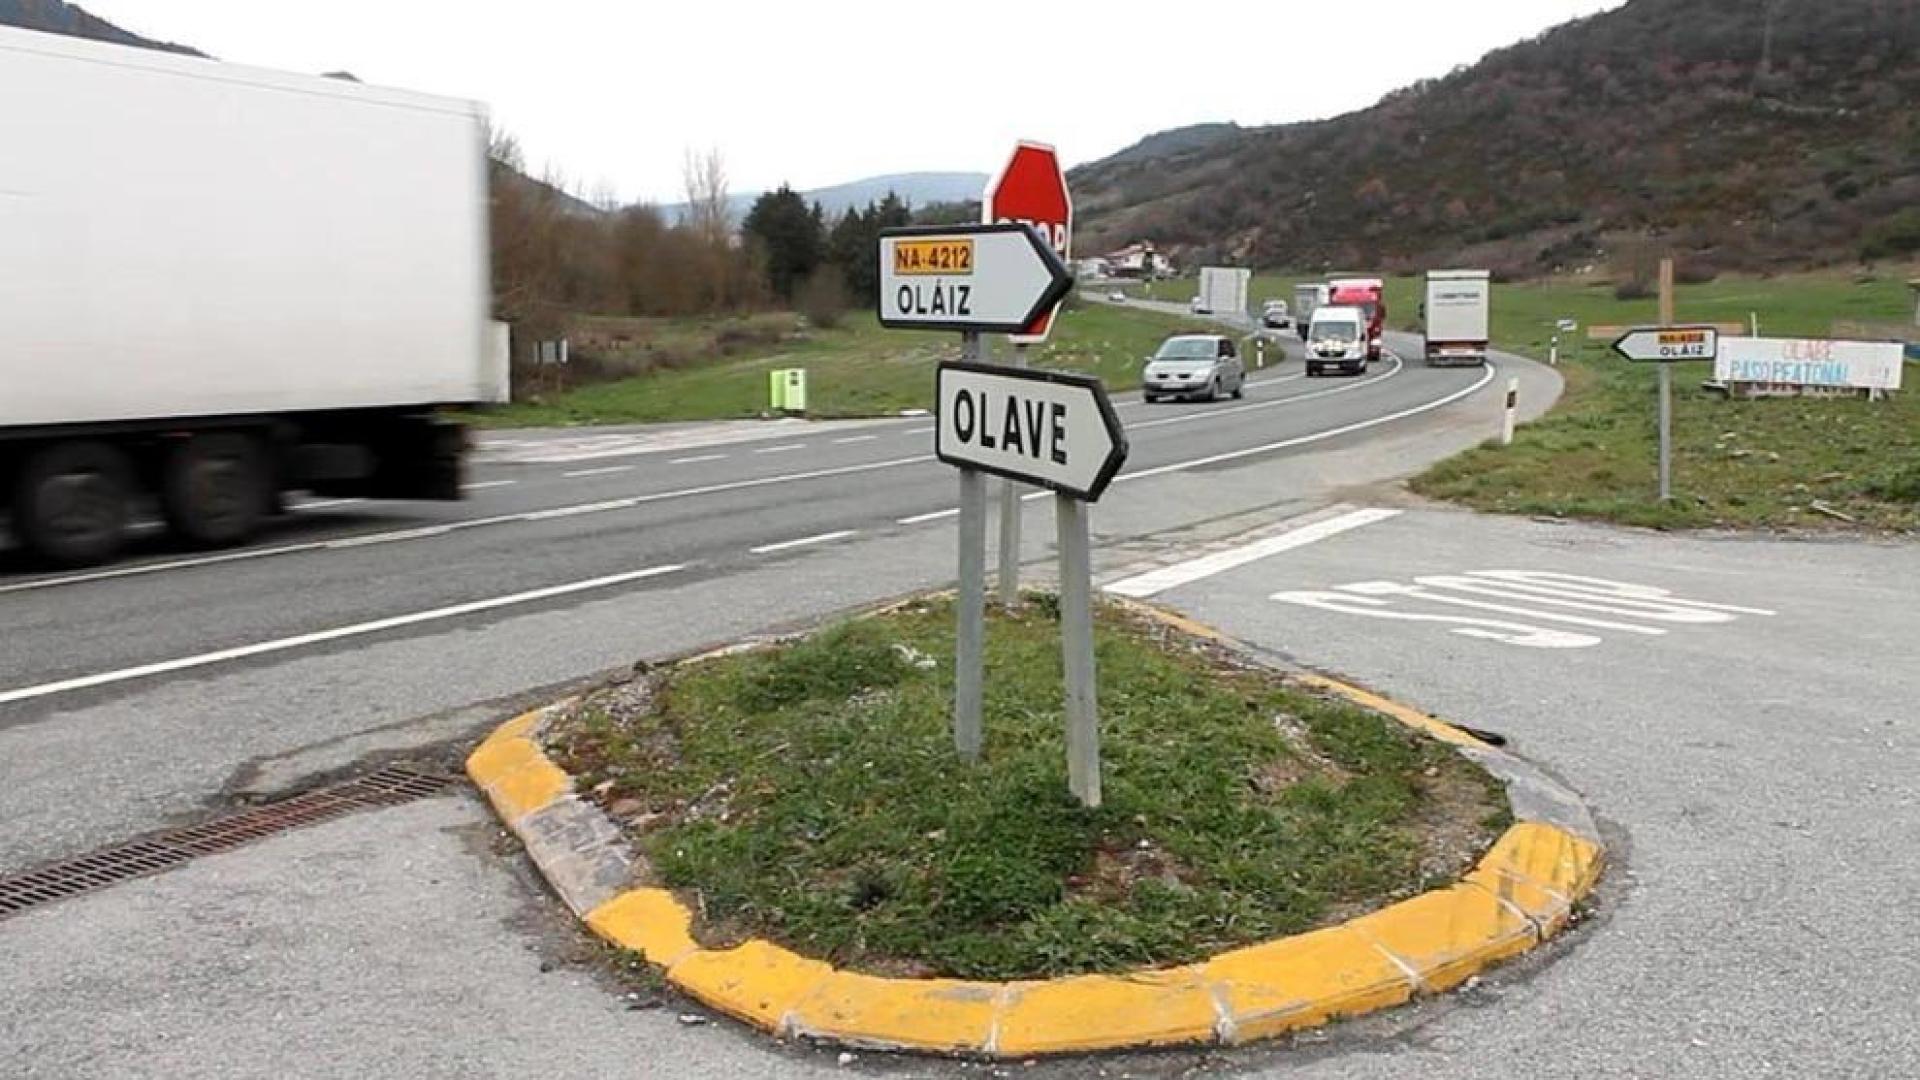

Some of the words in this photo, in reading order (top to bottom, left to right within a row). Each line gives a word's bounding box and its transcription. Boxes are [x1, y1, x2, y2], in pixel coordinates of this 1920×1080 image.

[897, 242, 969, 269] NA-4212
[898, 280, 970, 314] OLÁIZ
[954, 389, 1067, 465] OLAVE
